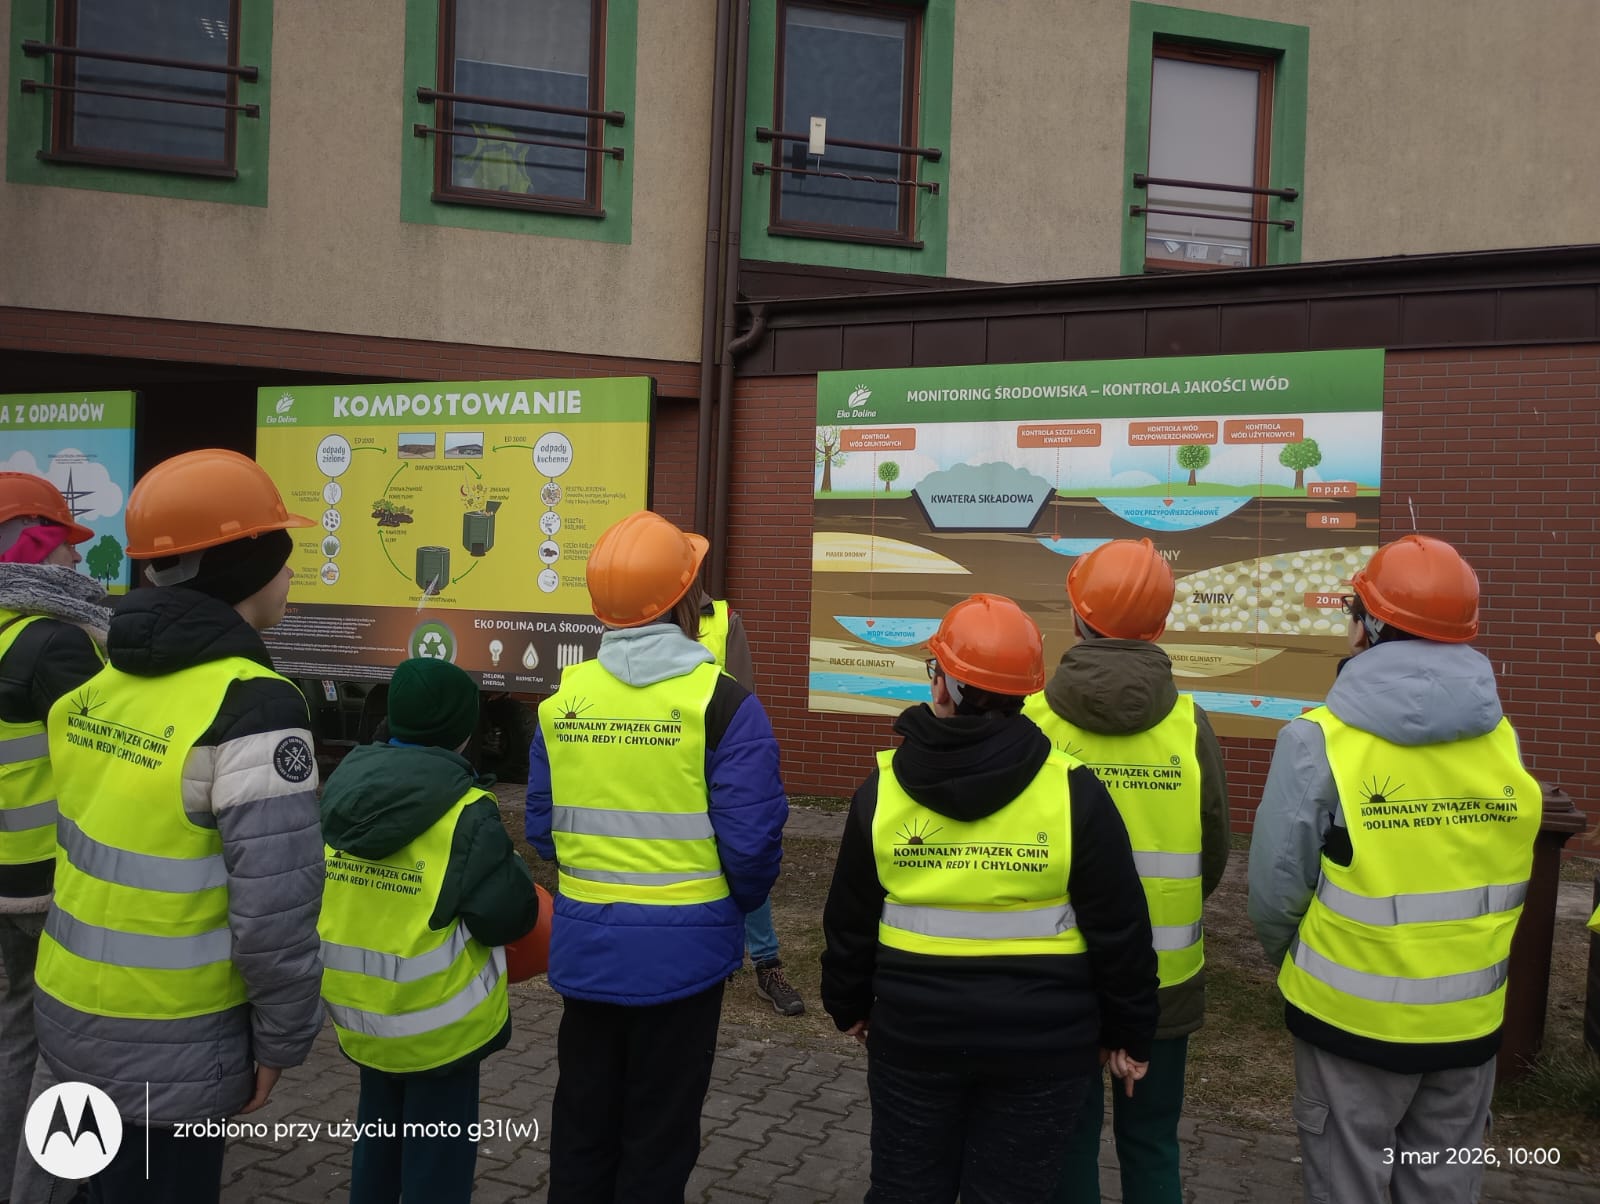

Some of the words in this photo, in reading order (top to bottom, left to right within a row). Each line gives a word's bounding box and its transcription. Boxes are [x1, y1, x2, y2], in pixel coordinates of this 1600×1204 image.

[907, 387, 991, 402] MONITORING
[994, 384, 1087, 400] ŚRODOWISKA
[1102, 382, 1180, 396] KONTROLA
[1184, 377, 1246, 394] JAKOŚCI
[1250, 376, 1290, 392] WÓD
[333, 390, 582, 418] KOMPOSTOWANIE
[16, 405, 24, 423] Z
[28, 398, 104, 423] ODPADÓW
[836, 410, 850, 418] Eko
[852, 409, 876, 418] Dolina
[266, 416, 277, 424] Eko
[278, 415, 298, 424] Dolina
[1132, 432, 1214, 440] PRZYPOWIERZCHNIOWYCH
[1248, 430, 1296, 438] UŻYTKOWYCH
[322, 446, 346, 456] odpady
[540, 444, 567, 454] odpady
[322, 455, 346, 463] zielone
[537, 454, 568, 464] kuchenne
[1324, 486, 1350, 496] p.p.t.
[931, 494, 976, 504] KWATERA
[978, 494, 1034, 504] SKŁADOWA
[1145, 508, 1220, 516] PRZYPOWIERZCHNIOWE
[1321, 515, 1328, 524] 8
[1193, 590, 1234, 604] ŻWIRY
[1316, 596, 1329, 604] 20
[1330, 597, 1340, 605] m
[474, 619, 494, 630] EKO
[497, 620, 534, 632] DOLINA
[536, 622, 557, 633] DLA
[559, 620, 604, 634] ŚRODOW
[884, 630, 916, 638] GRUNTOWE
[830, 658, 856, 667] PIASEK
[857, 658, 896, 668] GLINIASTY
[554, 722, 607, 731] KOMUNALNY
[610, 722, 650, 734] ZWIĄZEK
[654, 724, 682, 734] GMIN
[592, 734, 616, 744] REDY
[1104, 768, 1150, 778] ZWIĄZEK
[1152, 770, 1182, 778] GMIN
[1361, 804, 1428, 816] KOMUNALNY
[1432, 802, 1480, 812] ZWIĄZEK
[1484, 802, 1518, 811] GMIN
[1414, 816, 1442, 828] REDY
[894, 847, 962, 857] KOMUNALNY
[965, 846, 1012, 858] ZWIĄZEK
[1016, 848, 1048, 858] GMIN
[946, 860, 970, 869] REDY
[326, 860, 364, 873] OMUNALNY
[364, 866, 400, 880] ZWIĄZEK
[401, 872, 422, 884] GMIN
[324, 872, 348, 882] DOLINA
[350, 876, 369, 886] REDY
